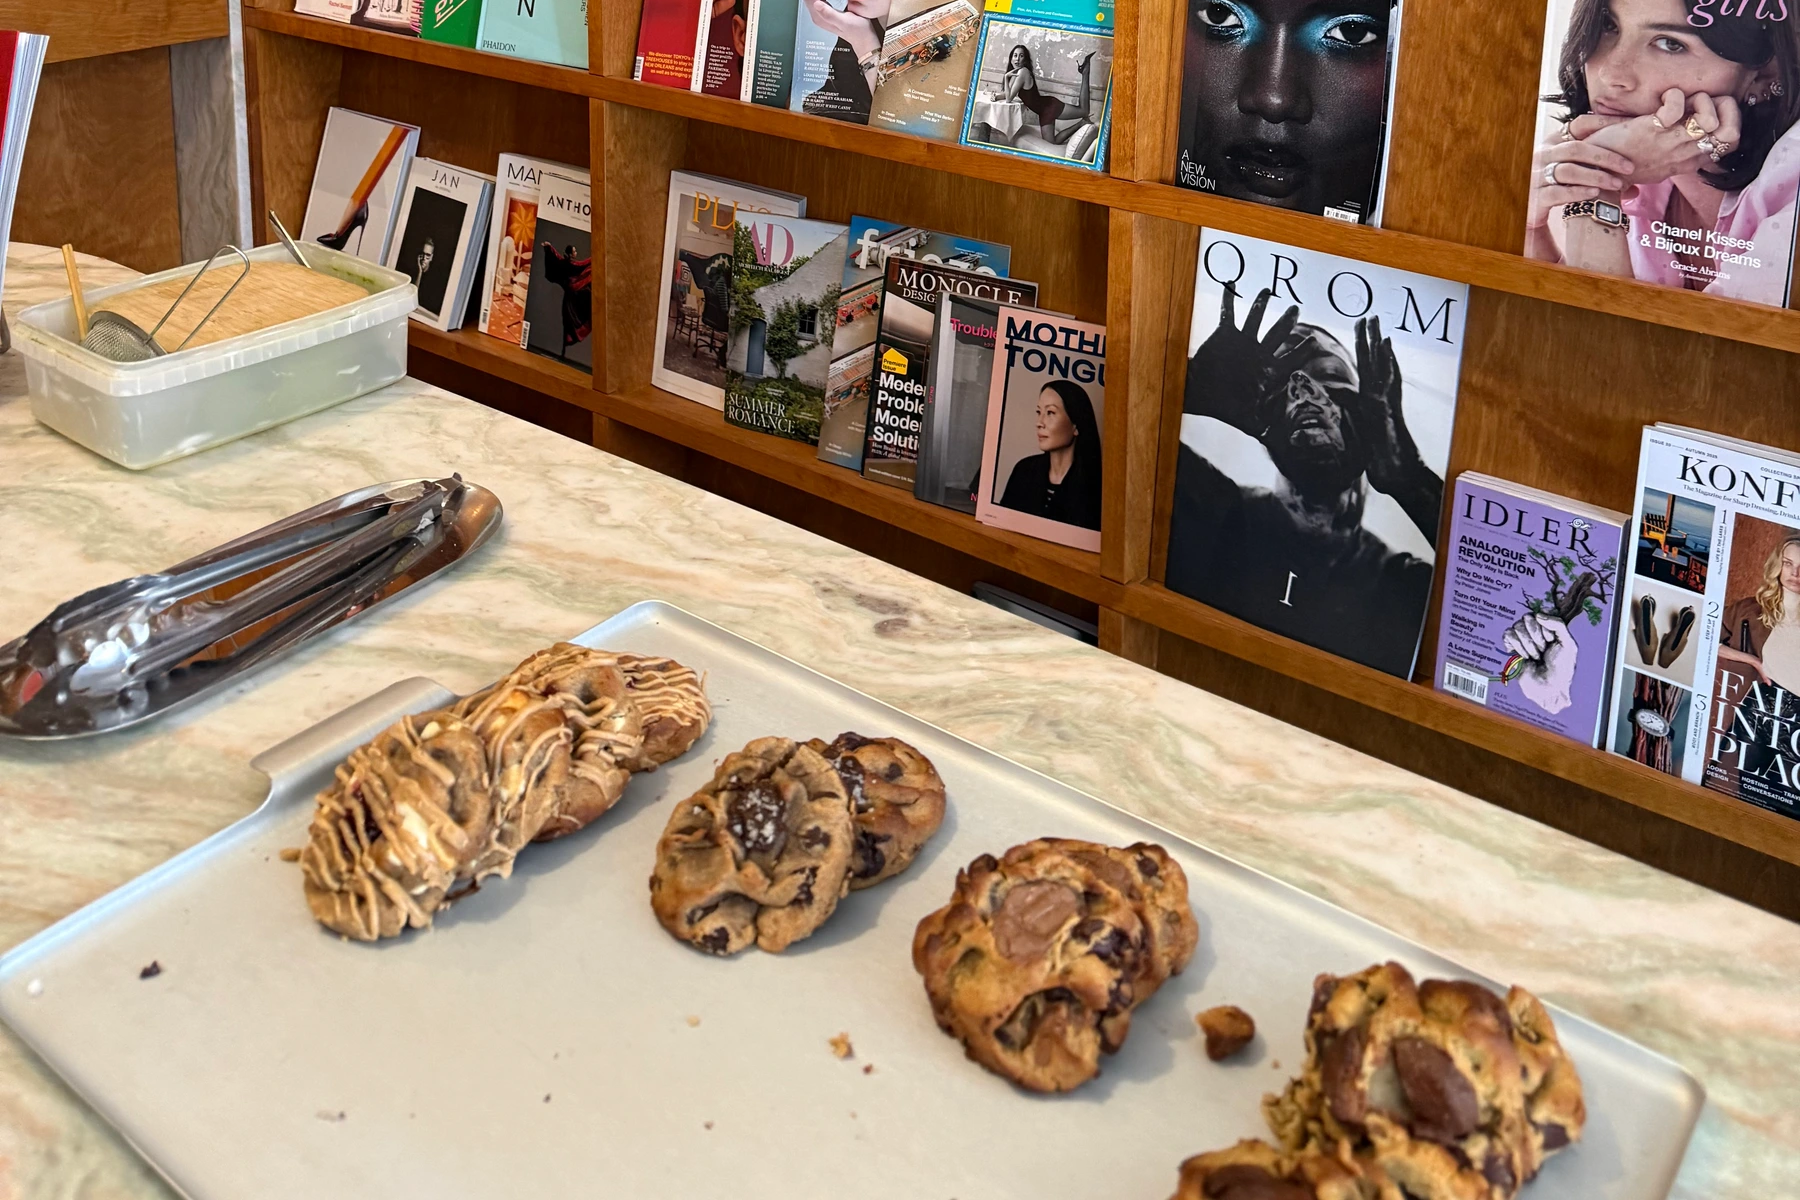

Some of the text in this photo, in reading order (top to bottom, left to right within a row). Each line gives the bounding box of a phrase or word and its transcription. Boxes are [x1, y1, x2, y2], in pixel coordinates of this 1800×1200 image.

[482, 39, 516, 52] PHAIDON
[1181, 149, 1190, 161] A
[431, 169, 460, 189] JAN
[1181, 160, 1206, 176] NEW
[1180, 171, 1216, 191] VISION
[547, 195, 591, 216] ANTHO
[750, 221, 794, 267] AD
[1651, 220, 1755, 251] Chanel Kisses
[1640, 234, 1762, 269] & Bijoux Dreams
[1670, 260, 1731, 280] Gracie Abrams
[897, 268, 1023, 305] MONOCLE
[1203, 239, 1458, 346] QROM
[1005, 316, 1107, 359] MOTH
[882, 364, 897, 372] Issue
[883, 358, 907, 369] Premiere
[729, 392, 786, 418] SUMMER
[728, 405, 797, 434] ROMANCE
[1676, 453, 1800, 509] KONF
[1683, 484, 1695, 492] The
[1696, 488, 1723, 500] Magazine
[1733, 497, 1751, 509] Sharp
[1751, 502, 1779, 516] Dressing,
[1463, 493, 1597, 558] IDLER
[1459, 535, 1527, 563] ANALOGUE
[1458, 546, 1536, 578] REVOLUTION
[1458, 555, 1469, 564] The
[1469, 558, 1484, 569] Only
[1484, 564, 1499, 574] Way
[1504, 569, 1519, 580] Back
[1279, 570, 1298, 606] I
[1456, 566, 1513, 589] Why Do We Cry?
[1453, 590, 1516, 615] Turn Off Your Mind
[1450, 619, 1474, 632] Beauty
[1451, 612, 1477, 627] Walking
[1454, 645, 1470, 655] Love
[1471, 649, 1502, 666] Supreme
[1706, 770, 1729, 782] DESIGN
[1707, 763, 1728, 775] LOOKS
[1741, 776, 1769, 790] HOSTING
[1743, 783, 1794, 806] CONVERSATIONS
